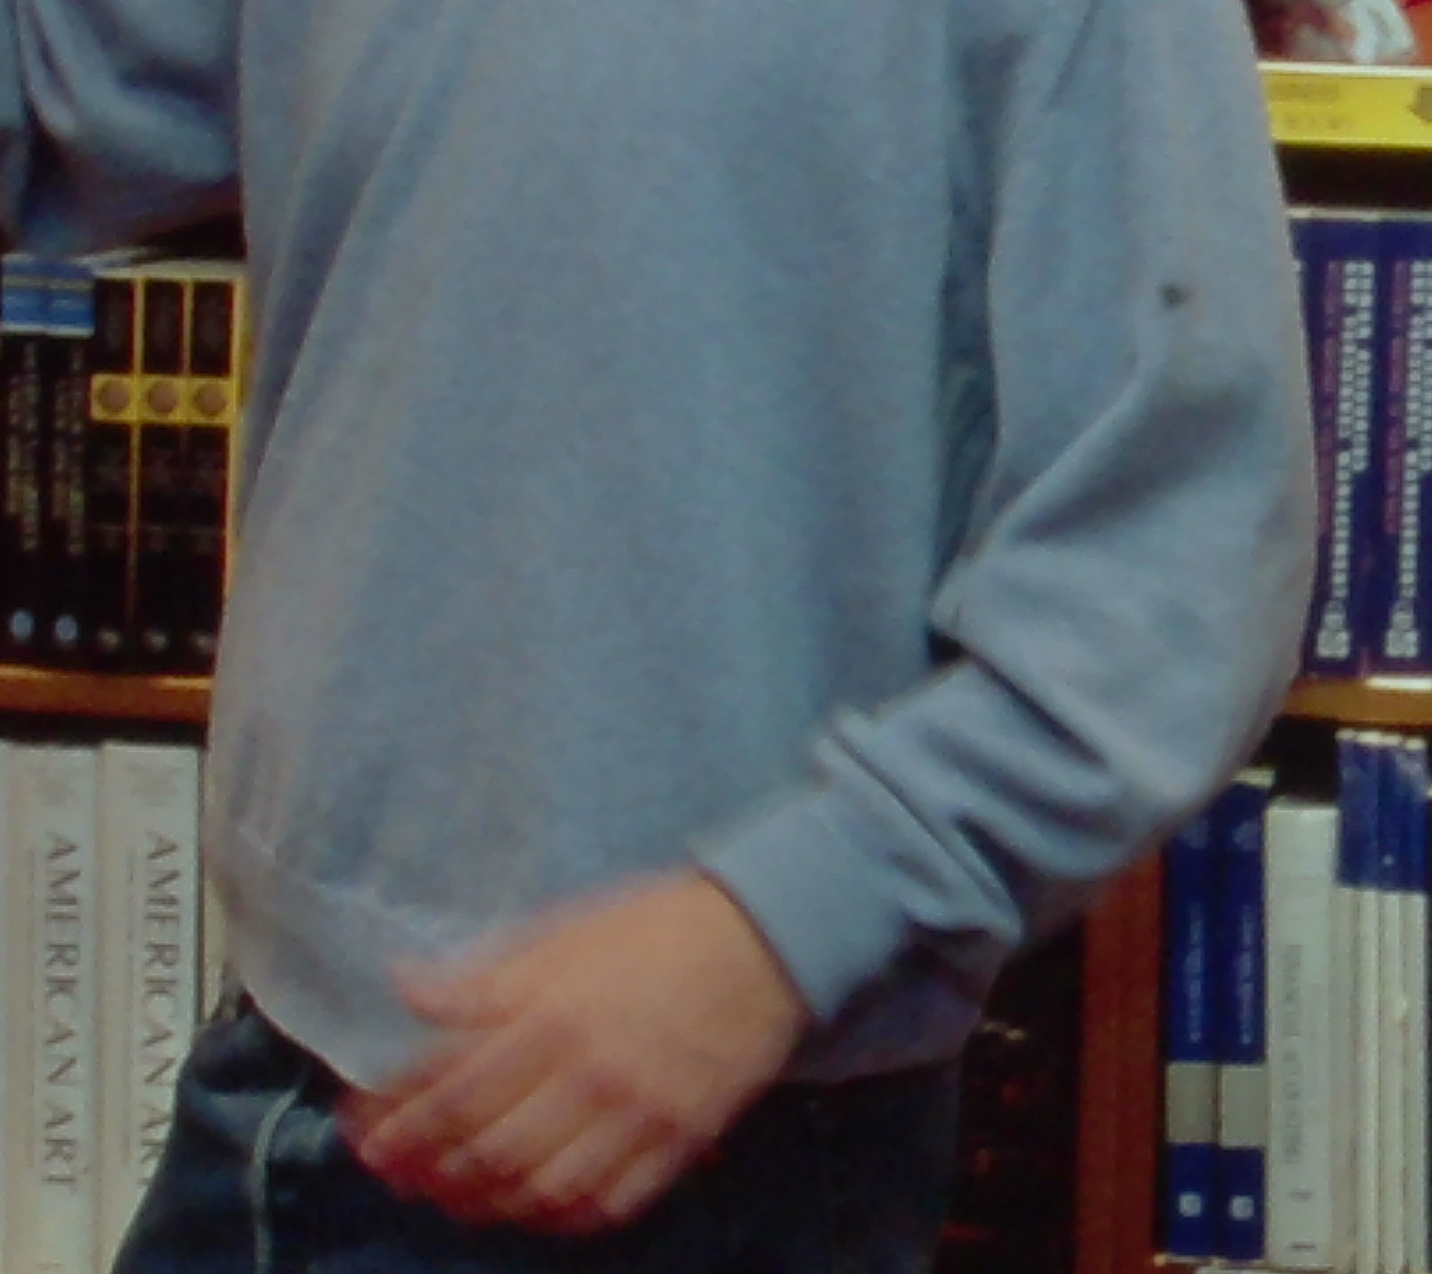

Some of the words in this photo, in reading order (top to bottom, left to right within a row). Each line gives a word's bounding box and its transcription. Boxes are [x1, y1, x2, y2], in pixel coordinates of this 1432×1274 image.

[43, 833, 82, 1087] AMERICAN
[141, 831, 182, 1087] AMERICAN
[41, 1105, 78, 1192] ART
